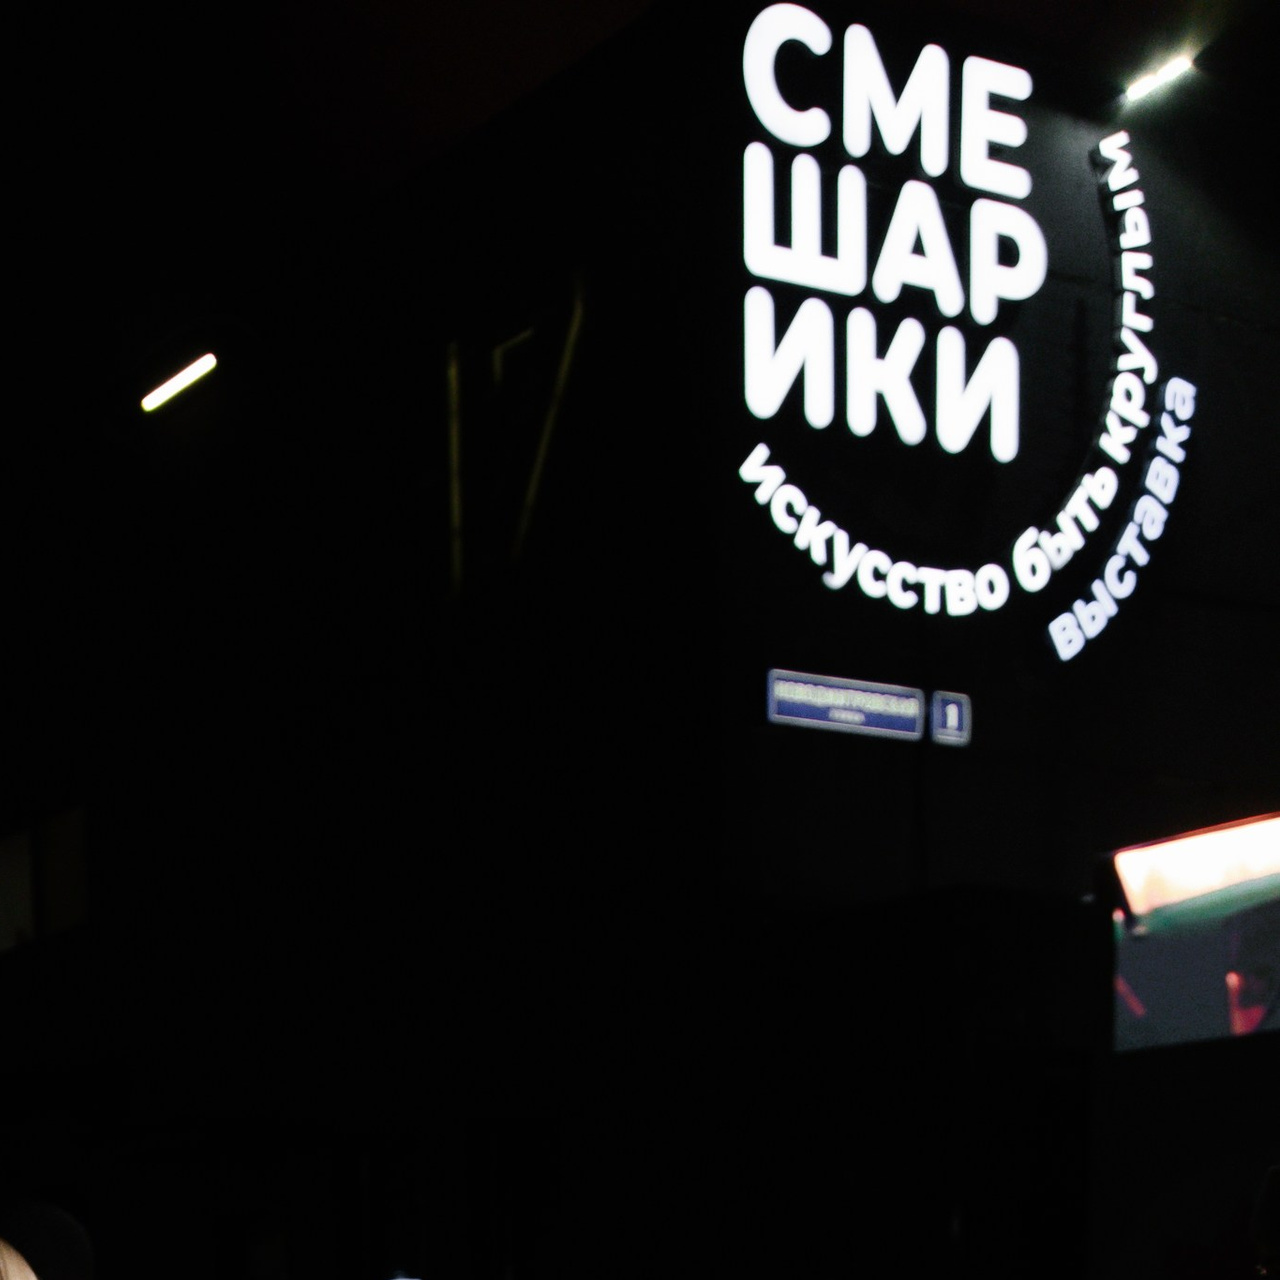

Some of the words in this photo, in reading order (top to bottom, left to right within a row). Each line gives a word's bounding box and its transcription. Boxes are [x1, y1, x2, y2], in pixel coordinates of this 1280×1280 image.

[742, 2, 1032, 199] СМЕ
[742, 142, 1048, 325] ШАР
[743, 286, 1020, 463] ИКИ
[1013, 466, 1118, 593] быть
[1099, 130, 1158, 464] круглым
